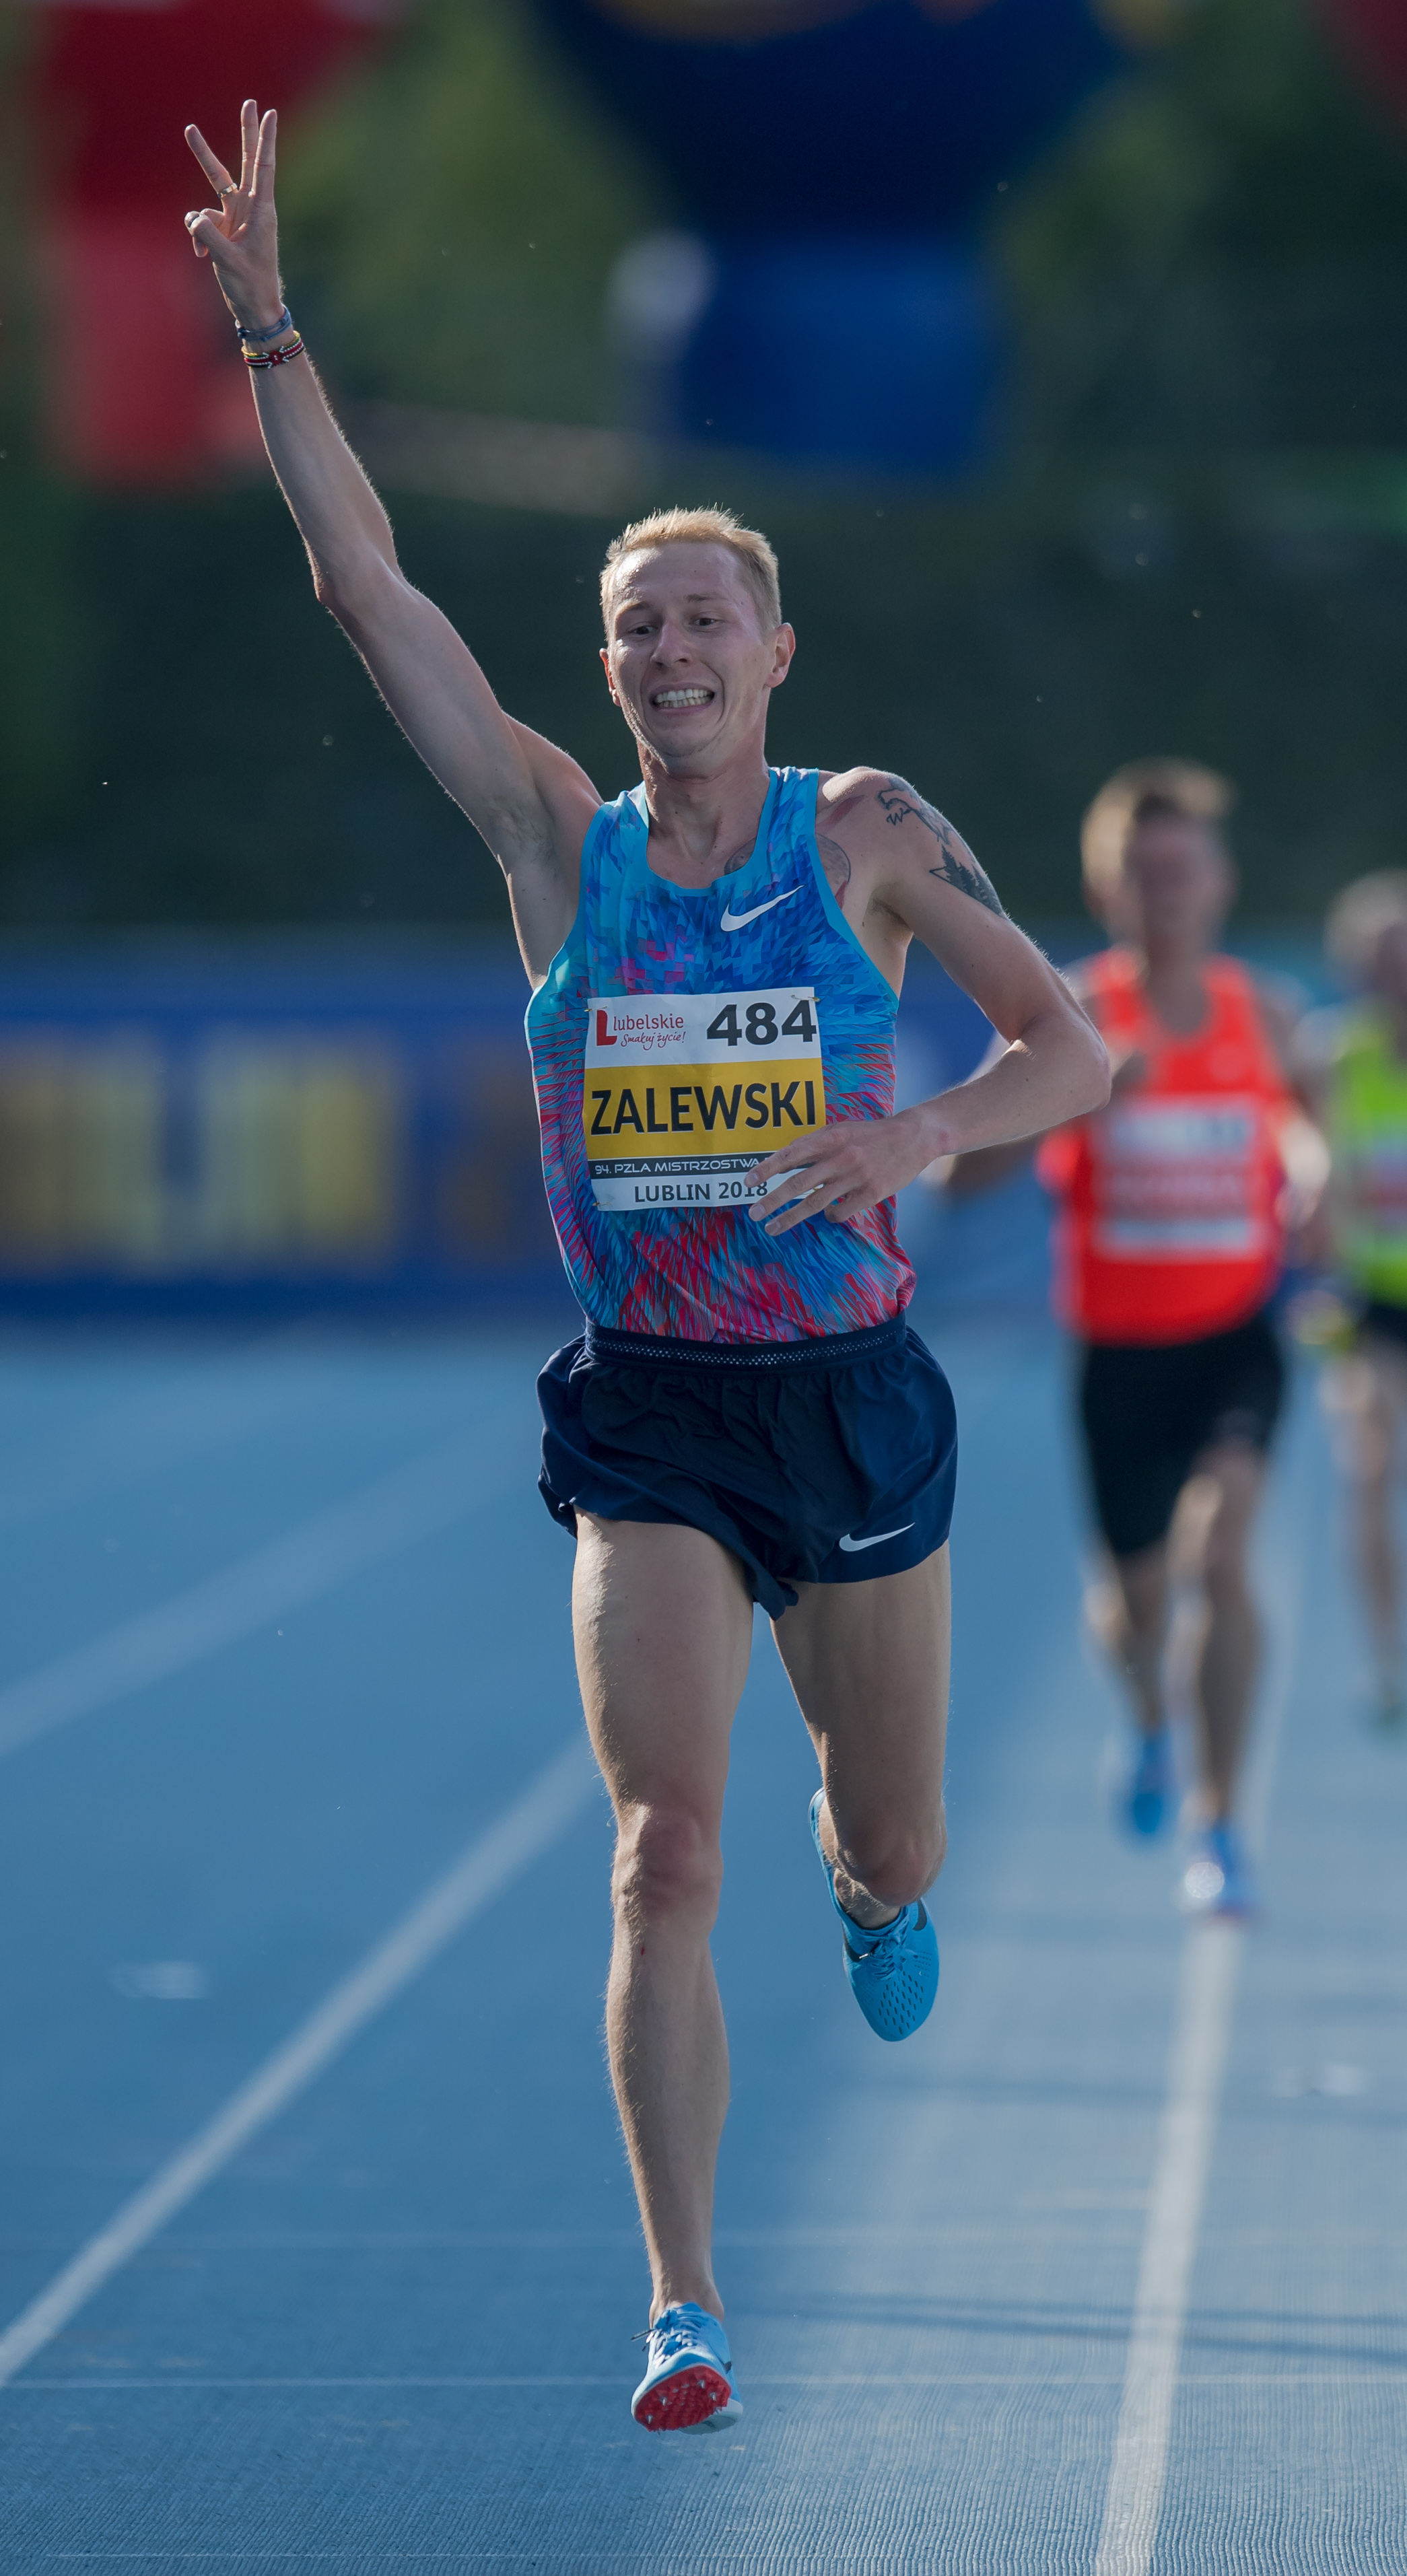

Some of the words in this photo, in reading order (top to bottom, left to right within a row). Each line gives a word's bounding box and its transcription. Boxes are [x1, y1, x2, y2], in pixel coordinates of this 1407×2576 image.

[707, 1000, 817, 1047] 484
[621, 1032, 656, 1051] Smakuj
[590, 1080, 817, 1136] ZALEWSKI
[595, 1164, 611, 1175] 94.
[615, 1162, 651, 1173] PZLA
[654, 1158, 759, 1172] MISTRZOSTWA
[635, 1183, 711, 1203] LUBLIN
[718, 1181, 768, 1199] 2018
